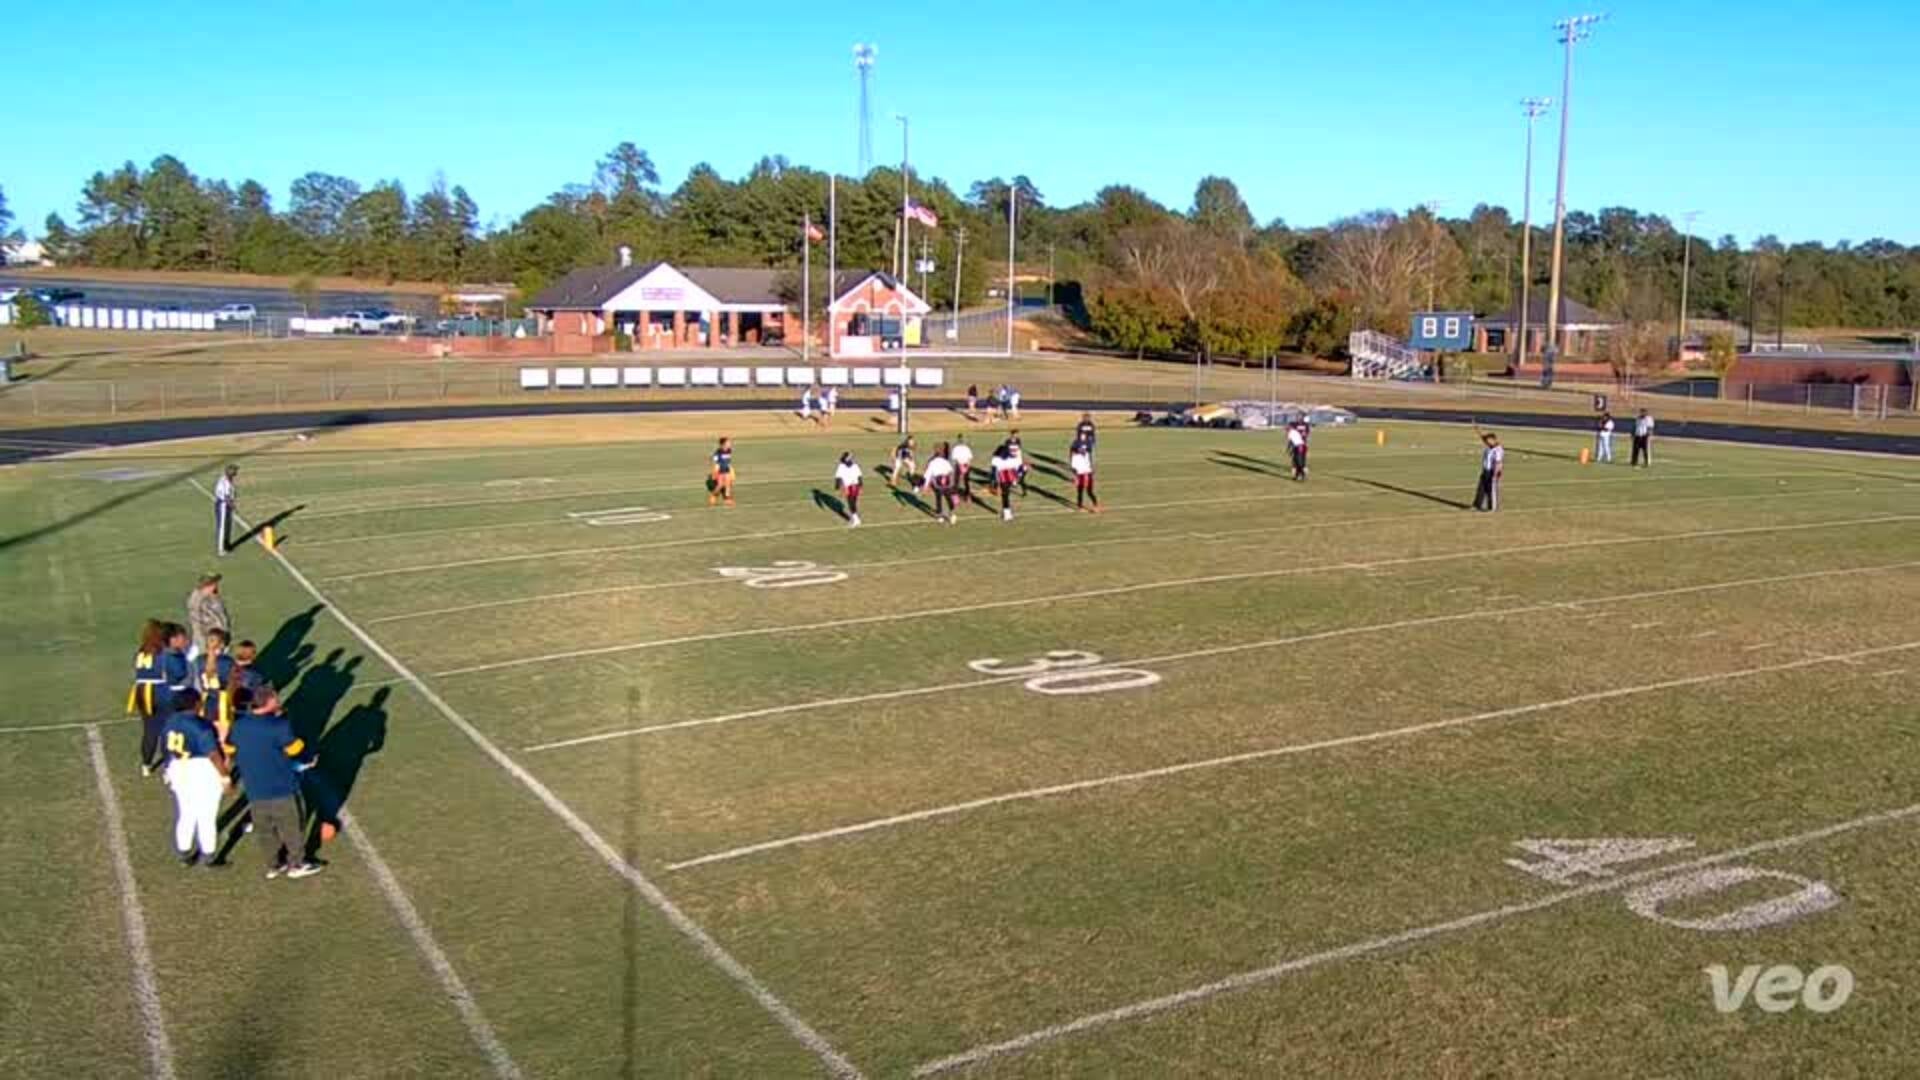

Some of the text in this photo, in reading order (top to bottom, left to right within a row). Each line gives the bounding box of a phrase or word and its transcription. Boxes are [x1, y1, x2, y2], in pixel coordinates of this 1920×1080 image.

[709, 560, 849, 588] 20
[968, 650, 1161, 694] 30
[1503, 837, 1840, 931] 40
